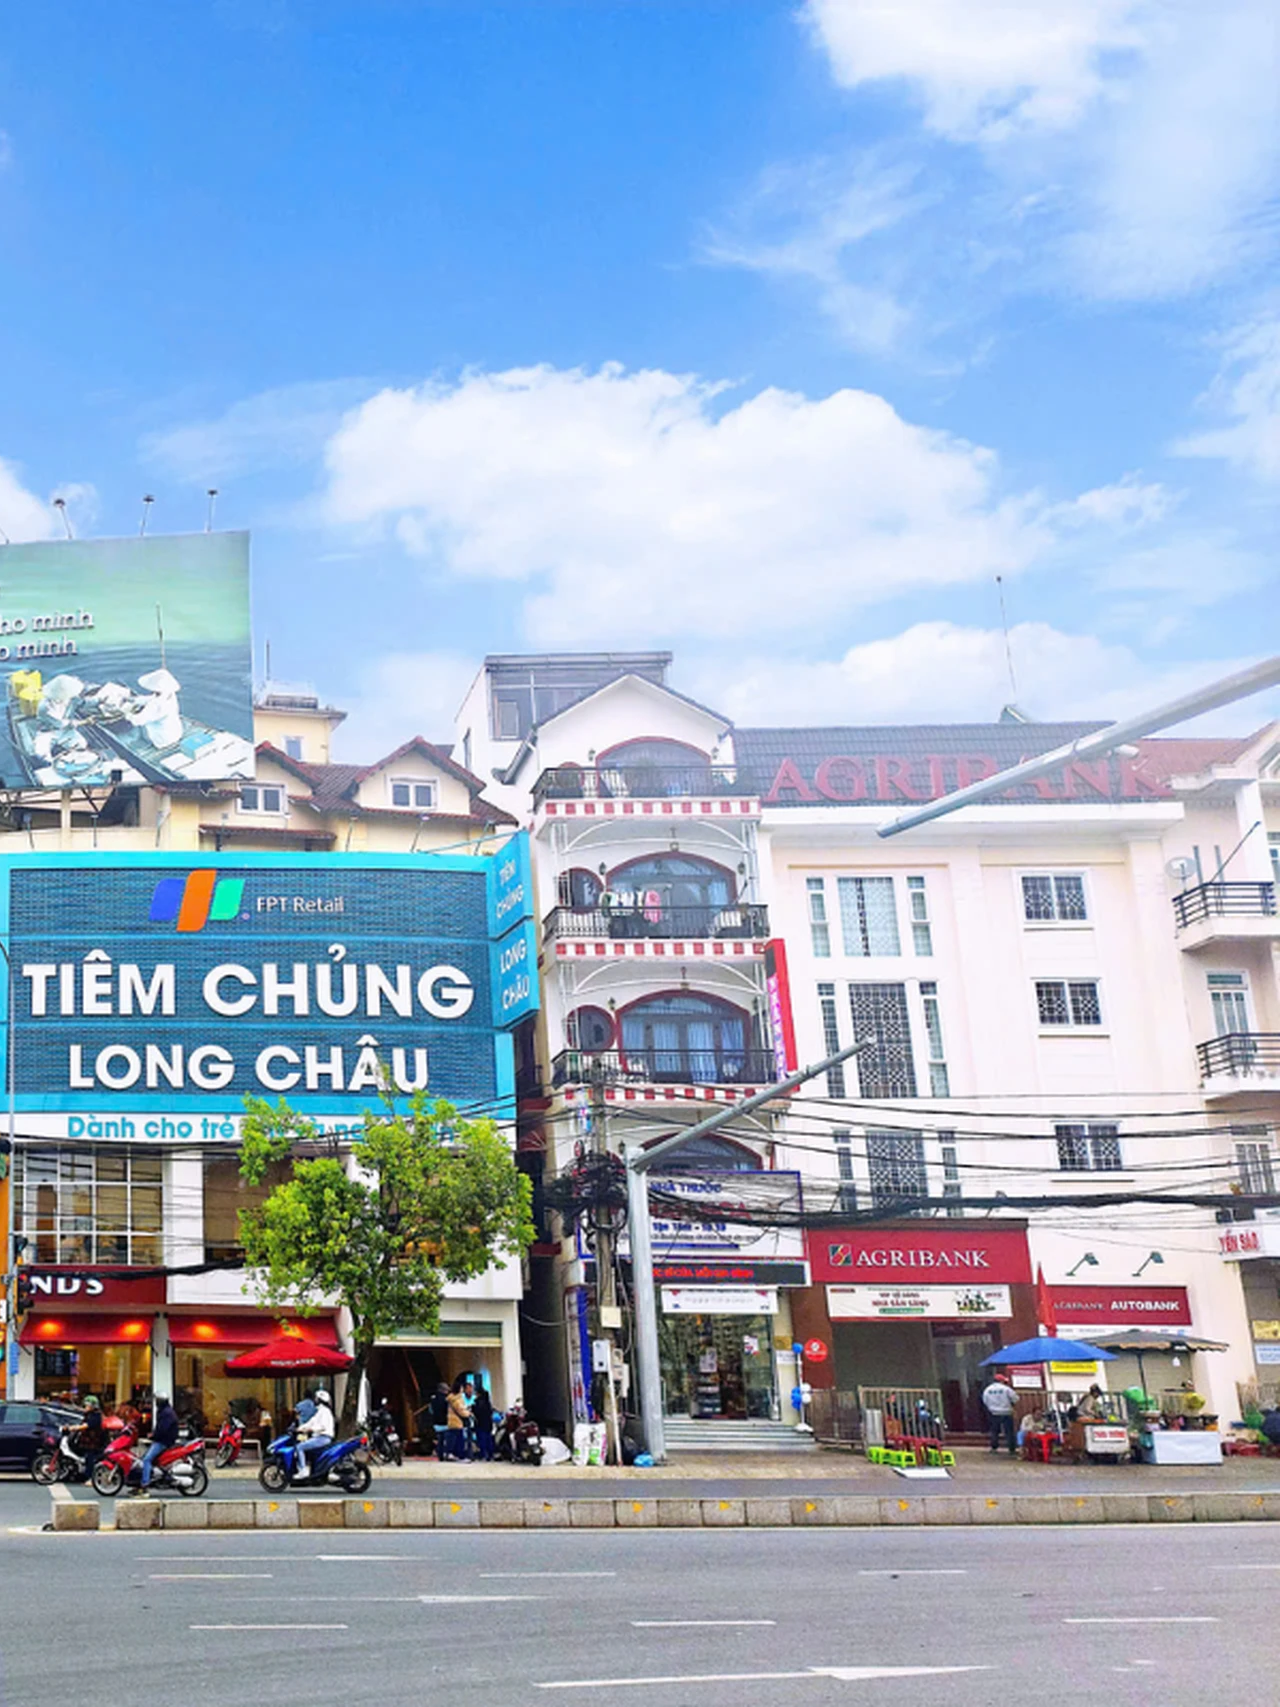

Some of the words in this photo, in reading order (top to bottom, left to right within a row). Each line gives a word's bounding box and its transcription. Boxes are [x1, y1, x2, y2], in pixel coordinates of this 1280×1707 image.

[766, 754, 1177, 802] AGRIBNK
[257, 896, 288, 913] FPT
[293, 896, 345, 913] Retail
[500, 938, 527, 975] LONG
[22, 948, 176, 1017] TIÊM
[202, 943, 475, 1020] CHỦNG
[68, 1043, 236, 1090] LONG
[255, 1033, 430, 1093] CHÂU
[67, 1113, 136, 1139] Dành
[143, 1116, 193, 1140] cho
[200, 1113, 236, 1140] trẻ
[856, 1249, 991, 1268] AGRIBANK
[1110, 1300, 1180, 1311] AUTOBANK
